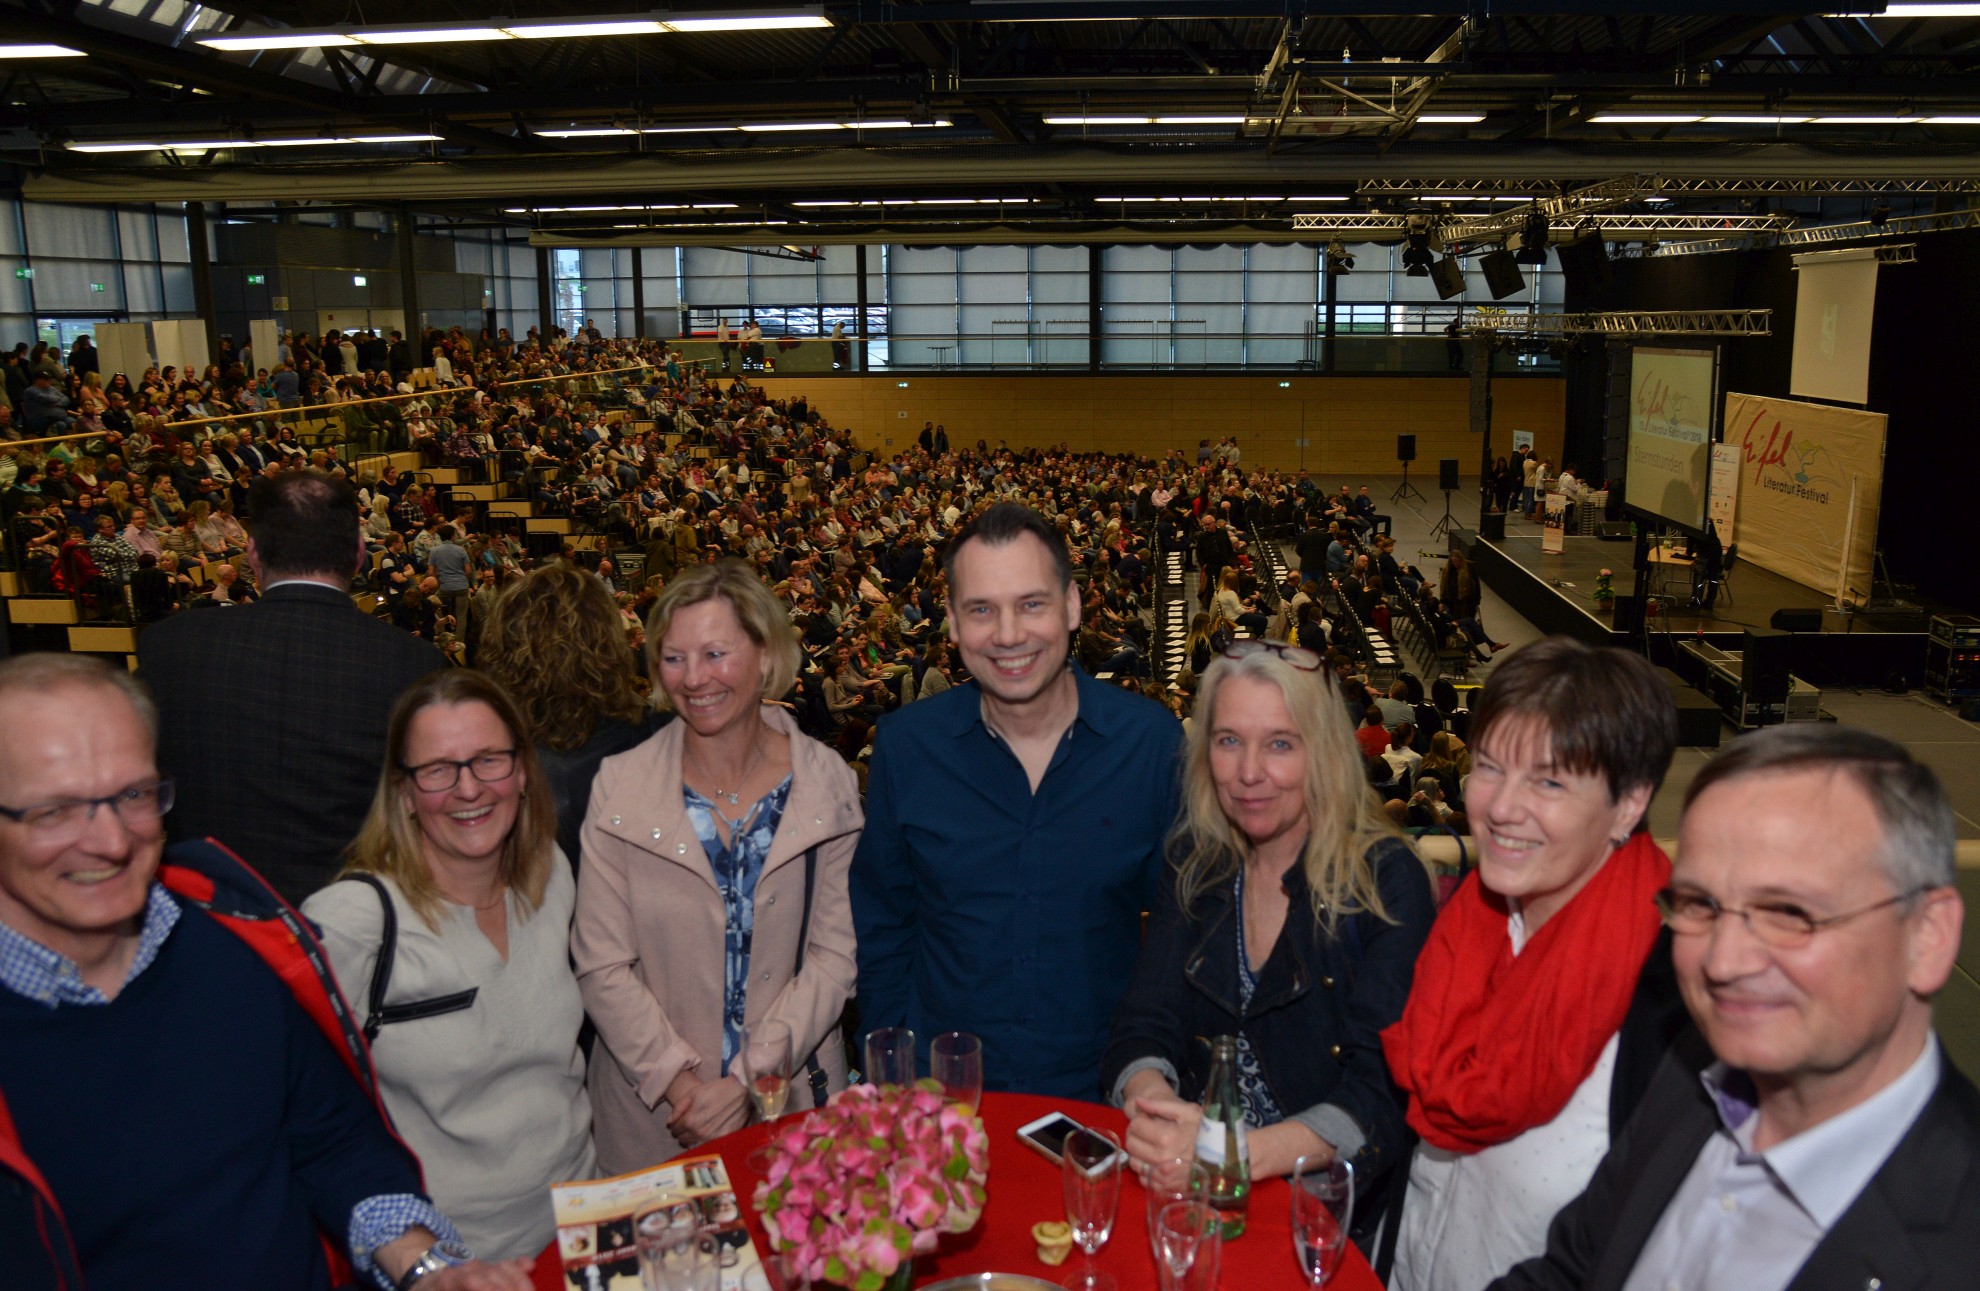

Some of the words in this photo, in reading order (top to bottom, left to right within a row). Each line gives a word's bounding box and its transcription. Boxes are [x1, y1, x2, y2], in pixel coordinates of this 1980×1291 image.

[1637, 370, 1669, 432] Eifel
[1634, 446, 1684, 474] Sternstunden
[1743, 408, 1793, 486] Eifel
[1763, 475, 1795, 495] Literatur
[1795, 484, 1829, 505] Festival
